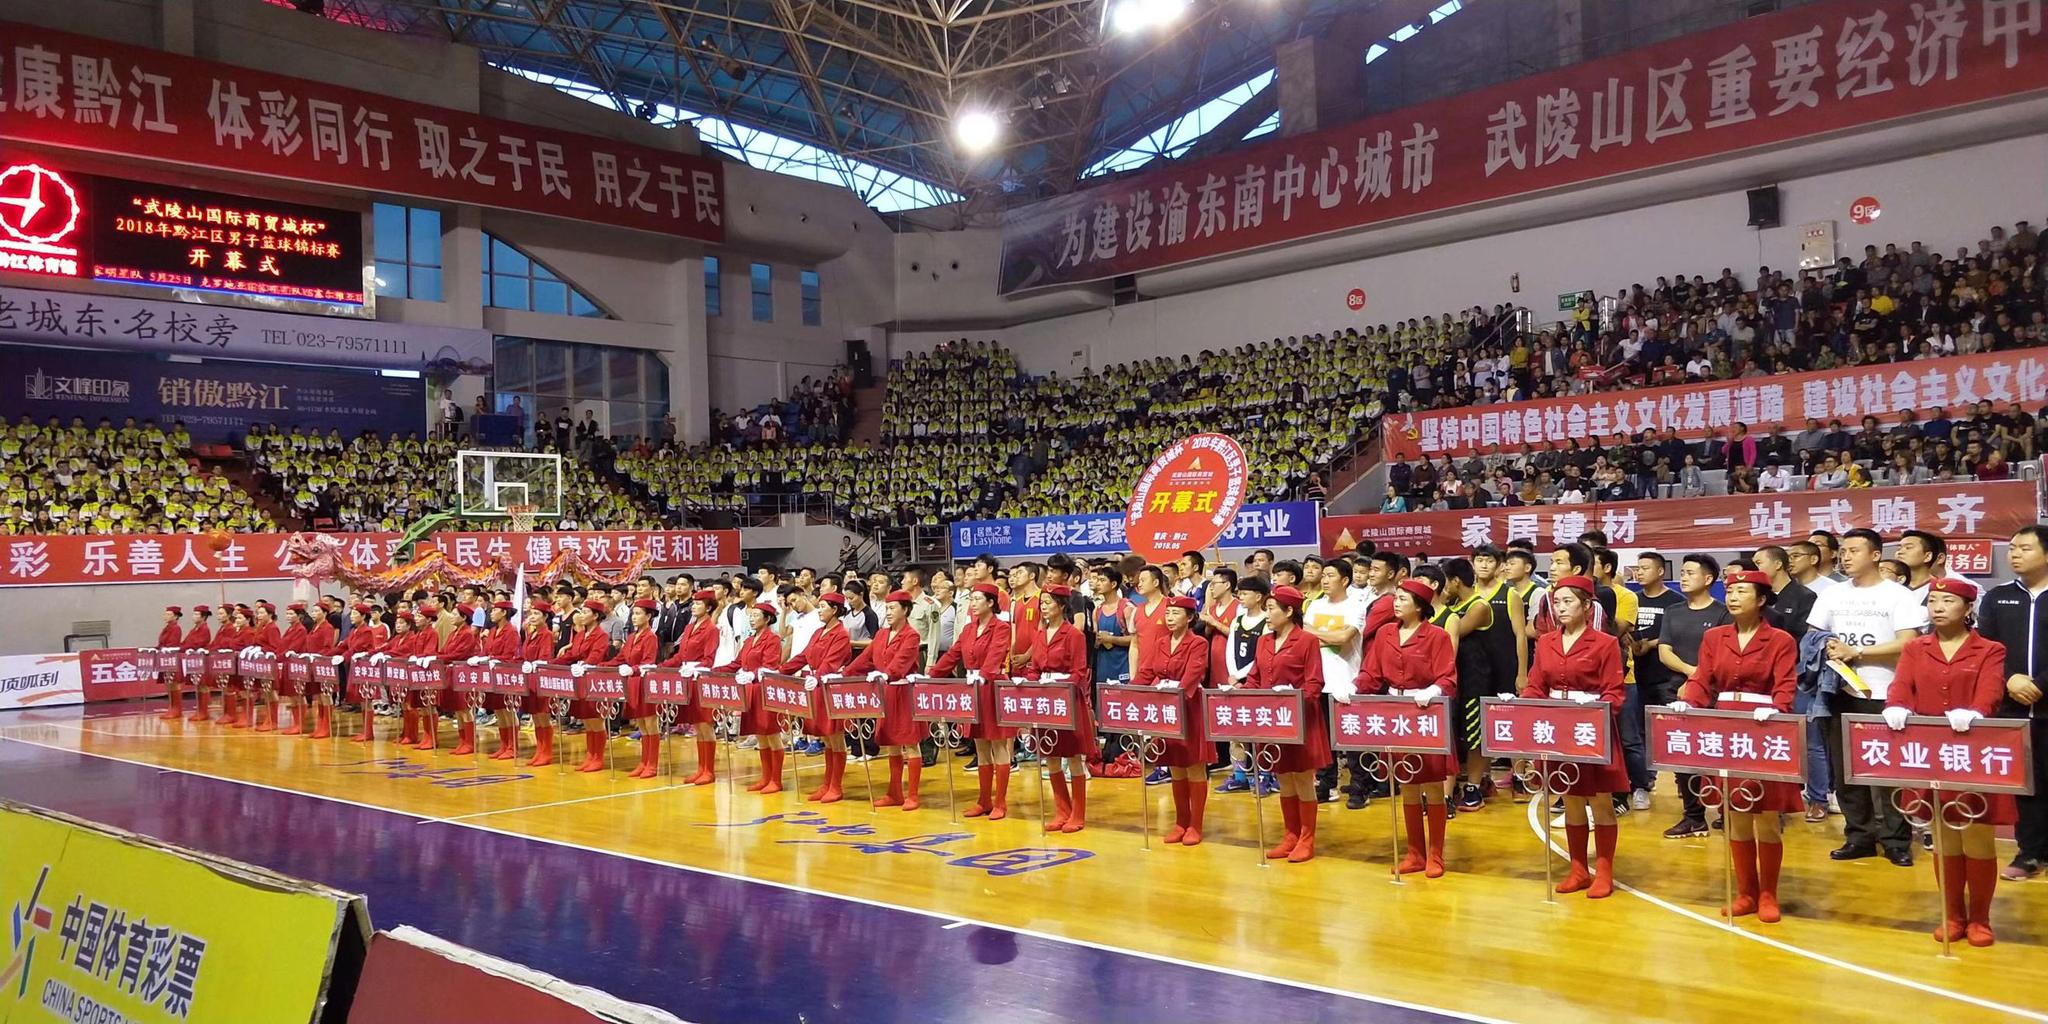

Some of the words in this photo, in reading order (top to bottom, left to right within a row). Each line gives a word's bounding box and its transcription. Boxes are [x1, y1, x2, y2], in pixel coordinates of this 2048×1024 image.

[0, 44, 178, 134] 康黔江
[206, 78, 394, 173] 体彩同行
[416, 116, 573, 200] 取之于民
[593, 151, 722, 226] 用之于民
[1054, 121, 1441, 269] 为建设渝东南中心城市
[1483, 0, 2042, 180] 武陵山区重要经济中
[1853, 205, 1876, 218] 9区
[115, 217, 341, 259] 2018年黔江区男子篮球锦标赛
[188, 248, 280, 277] 开幕式
[53, 376, 129, 398] 文峰印象
[158, 376, 289, 410] 销傲黔江
[1420, 383, 1784, 452] 坚持中国特色社会主义文化发展道路
[1802, 357, 2046, 420] 建设社会主义文化
[1149, 490, 1218, 513] 开幕式
[977, 526, 1011, 538] 居然之家
[1460, 507, 1638, 550] 家居建材
[1693, 493, 1986, 540] 一站式购齐
[974, 534, 1012, 549] Easyhome
[82, 539, 249, 576] 乐善人生
[1239, 641, 1248, 658] 5
[457, 671, 491, 684] 公安局
[589, 679, 624, 694] 人大机关
[650, 680, 684, 695] 裁判员
[702, 683, 741, 701] 消防支队
[766, 684, 808, 707] 安畅交通
[832, 692, 881, 710] 职教中心
[917, 693, 973, 712] 北门分校
[1003, 696, 1068, 717] 和平药房
[1107, 701, 1178, 725] 石会龙博
[1215, 705, 1293, 728] 荣丰实业
[1340, 713, 1439, 738] 泰来水利
[1494, 719, 1598, 747] 区教委
[1666, 729, 1792, 763] 高速执法
[1861, 739, 2014, 776] 农业银行
[60, 894, 206, 1019] 中国体育彩票
[43, 979, 76, 1018] CHINA
